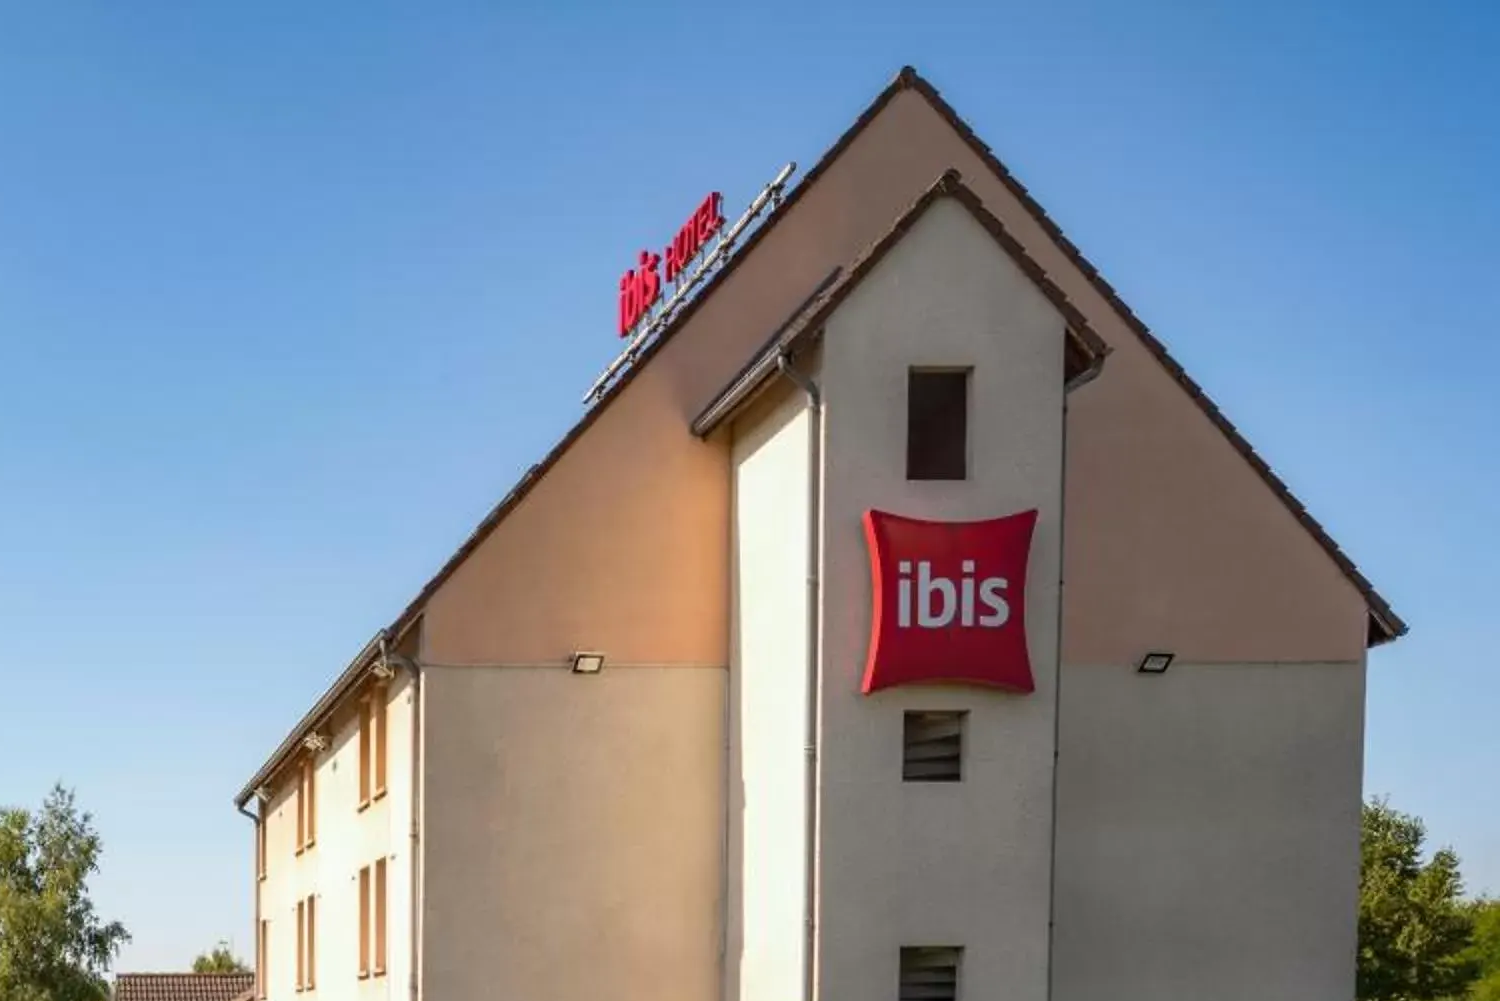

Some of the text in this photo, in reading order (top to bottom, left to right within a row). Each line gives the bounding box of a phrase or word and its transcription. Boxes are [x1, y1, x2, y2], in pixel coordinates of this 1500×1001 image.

[618, 191, 726, 339] ibis HOTEL
[897, 559, 1010, 629] ibis
